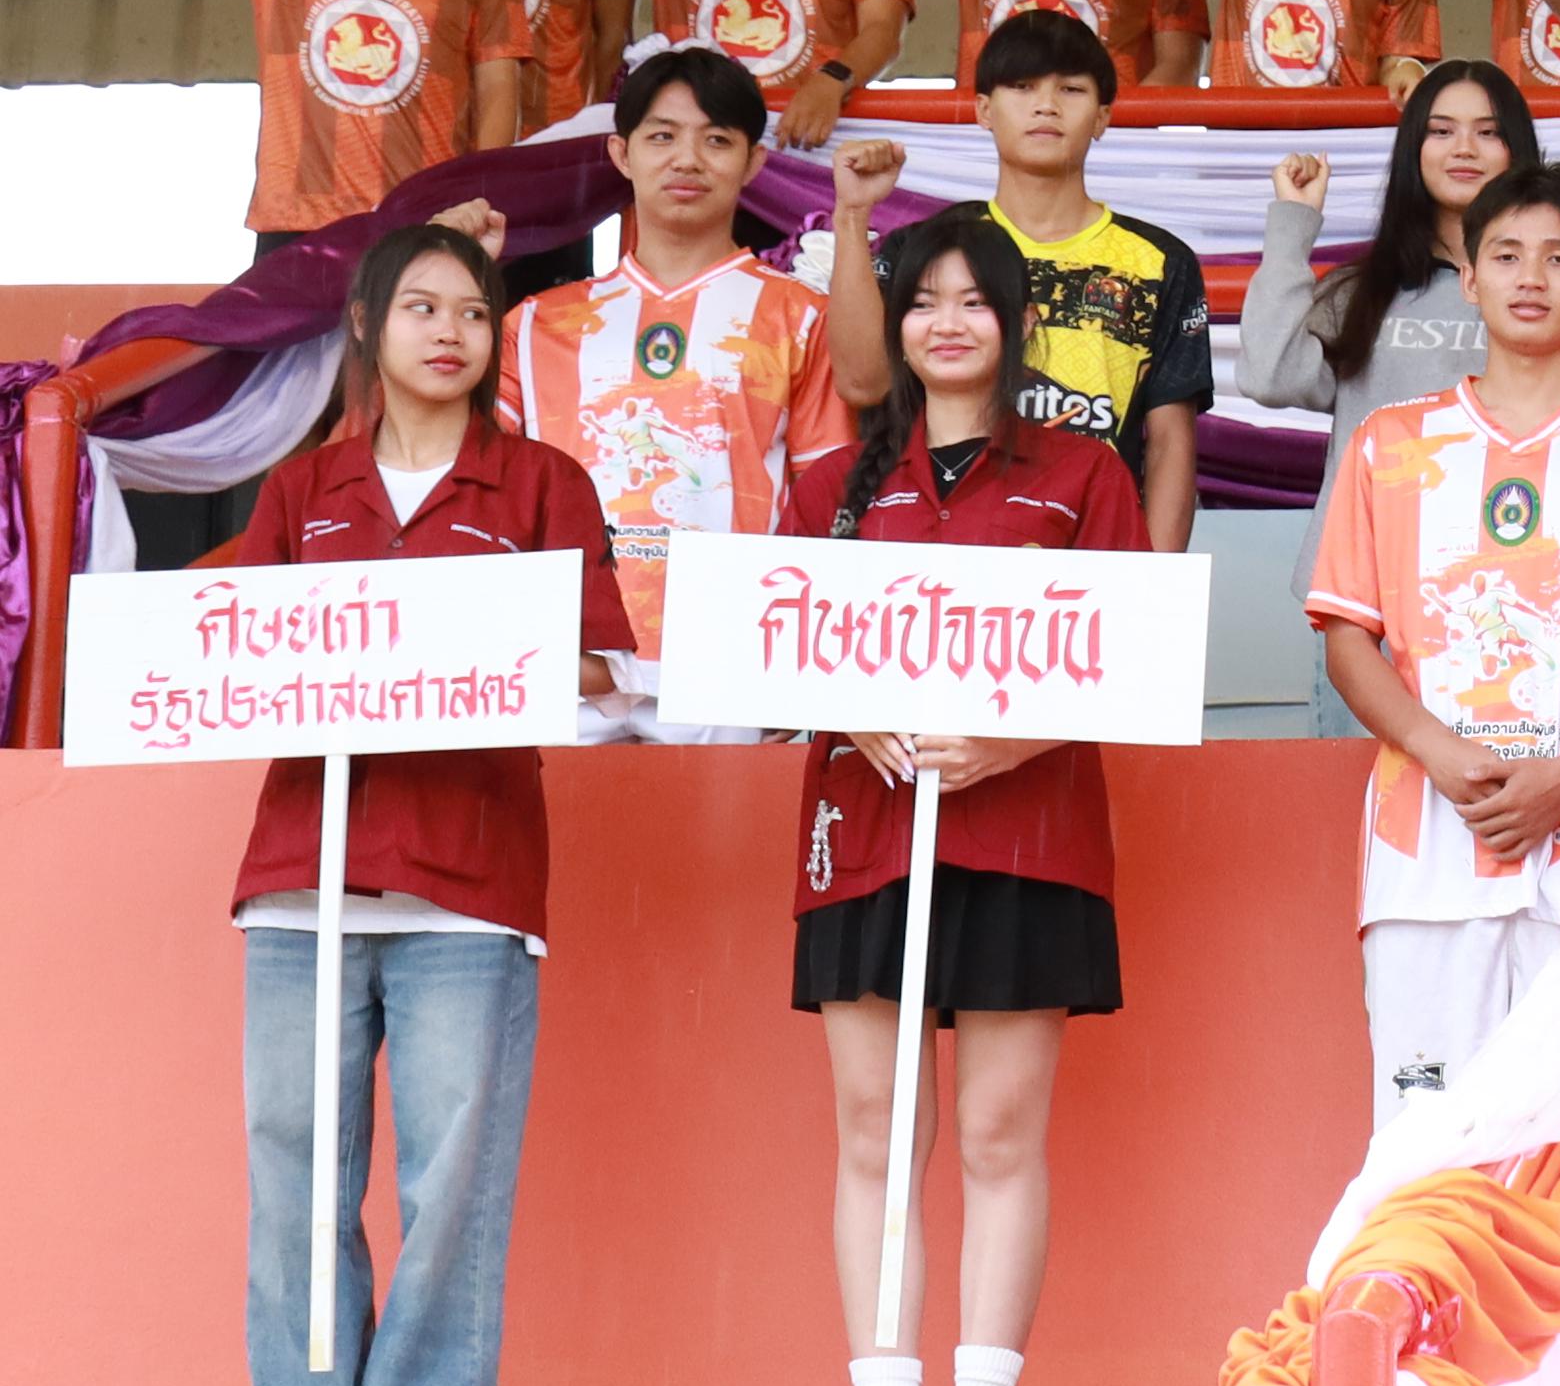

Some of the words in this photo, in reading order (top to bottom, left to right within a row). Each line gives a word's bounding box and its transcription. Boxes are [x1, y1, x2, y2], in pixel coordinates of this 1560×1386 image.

[1016, 384, 1113, 430] ritos
[194, 575, 400, 659] ศิษย์เก่า
